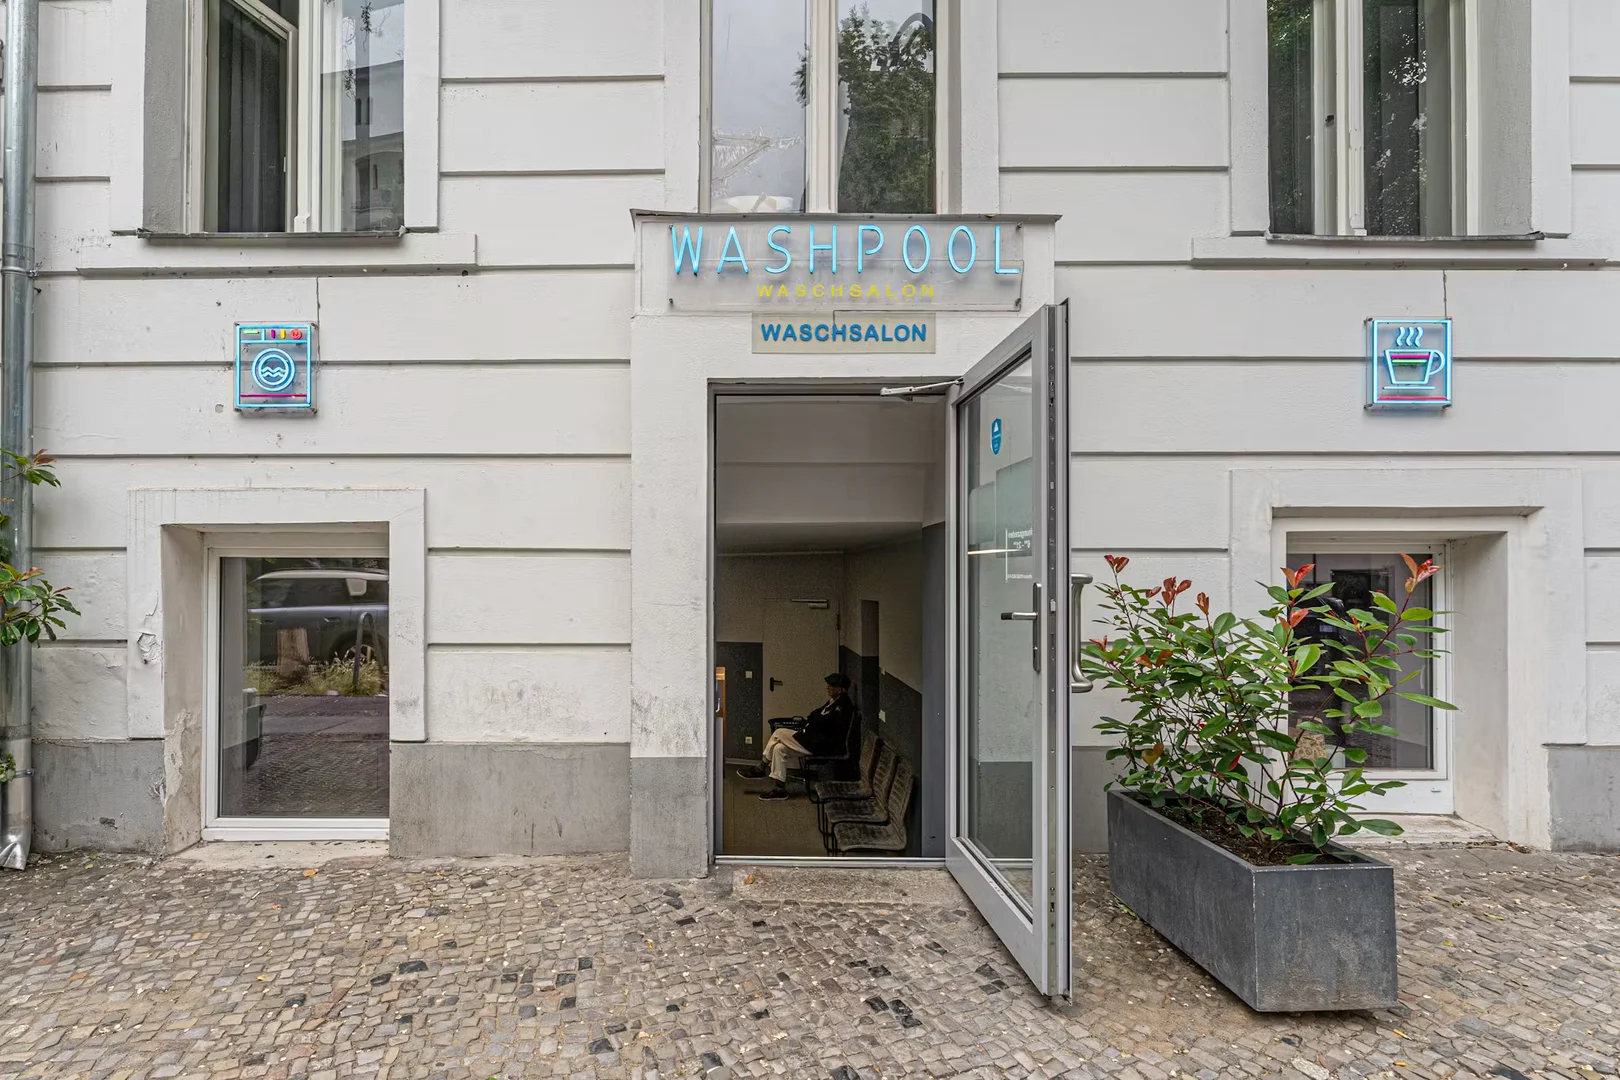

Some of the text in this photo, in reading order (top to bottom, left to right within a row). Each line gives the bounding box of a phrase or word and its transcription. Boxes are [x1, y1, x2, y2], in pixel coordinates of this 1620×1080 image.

[671, 224, 1020, 275] WASHPOOL
[756, 283, 936, 299] WASCHSALON
[760, 323, 927, 342] WASCHSALON
